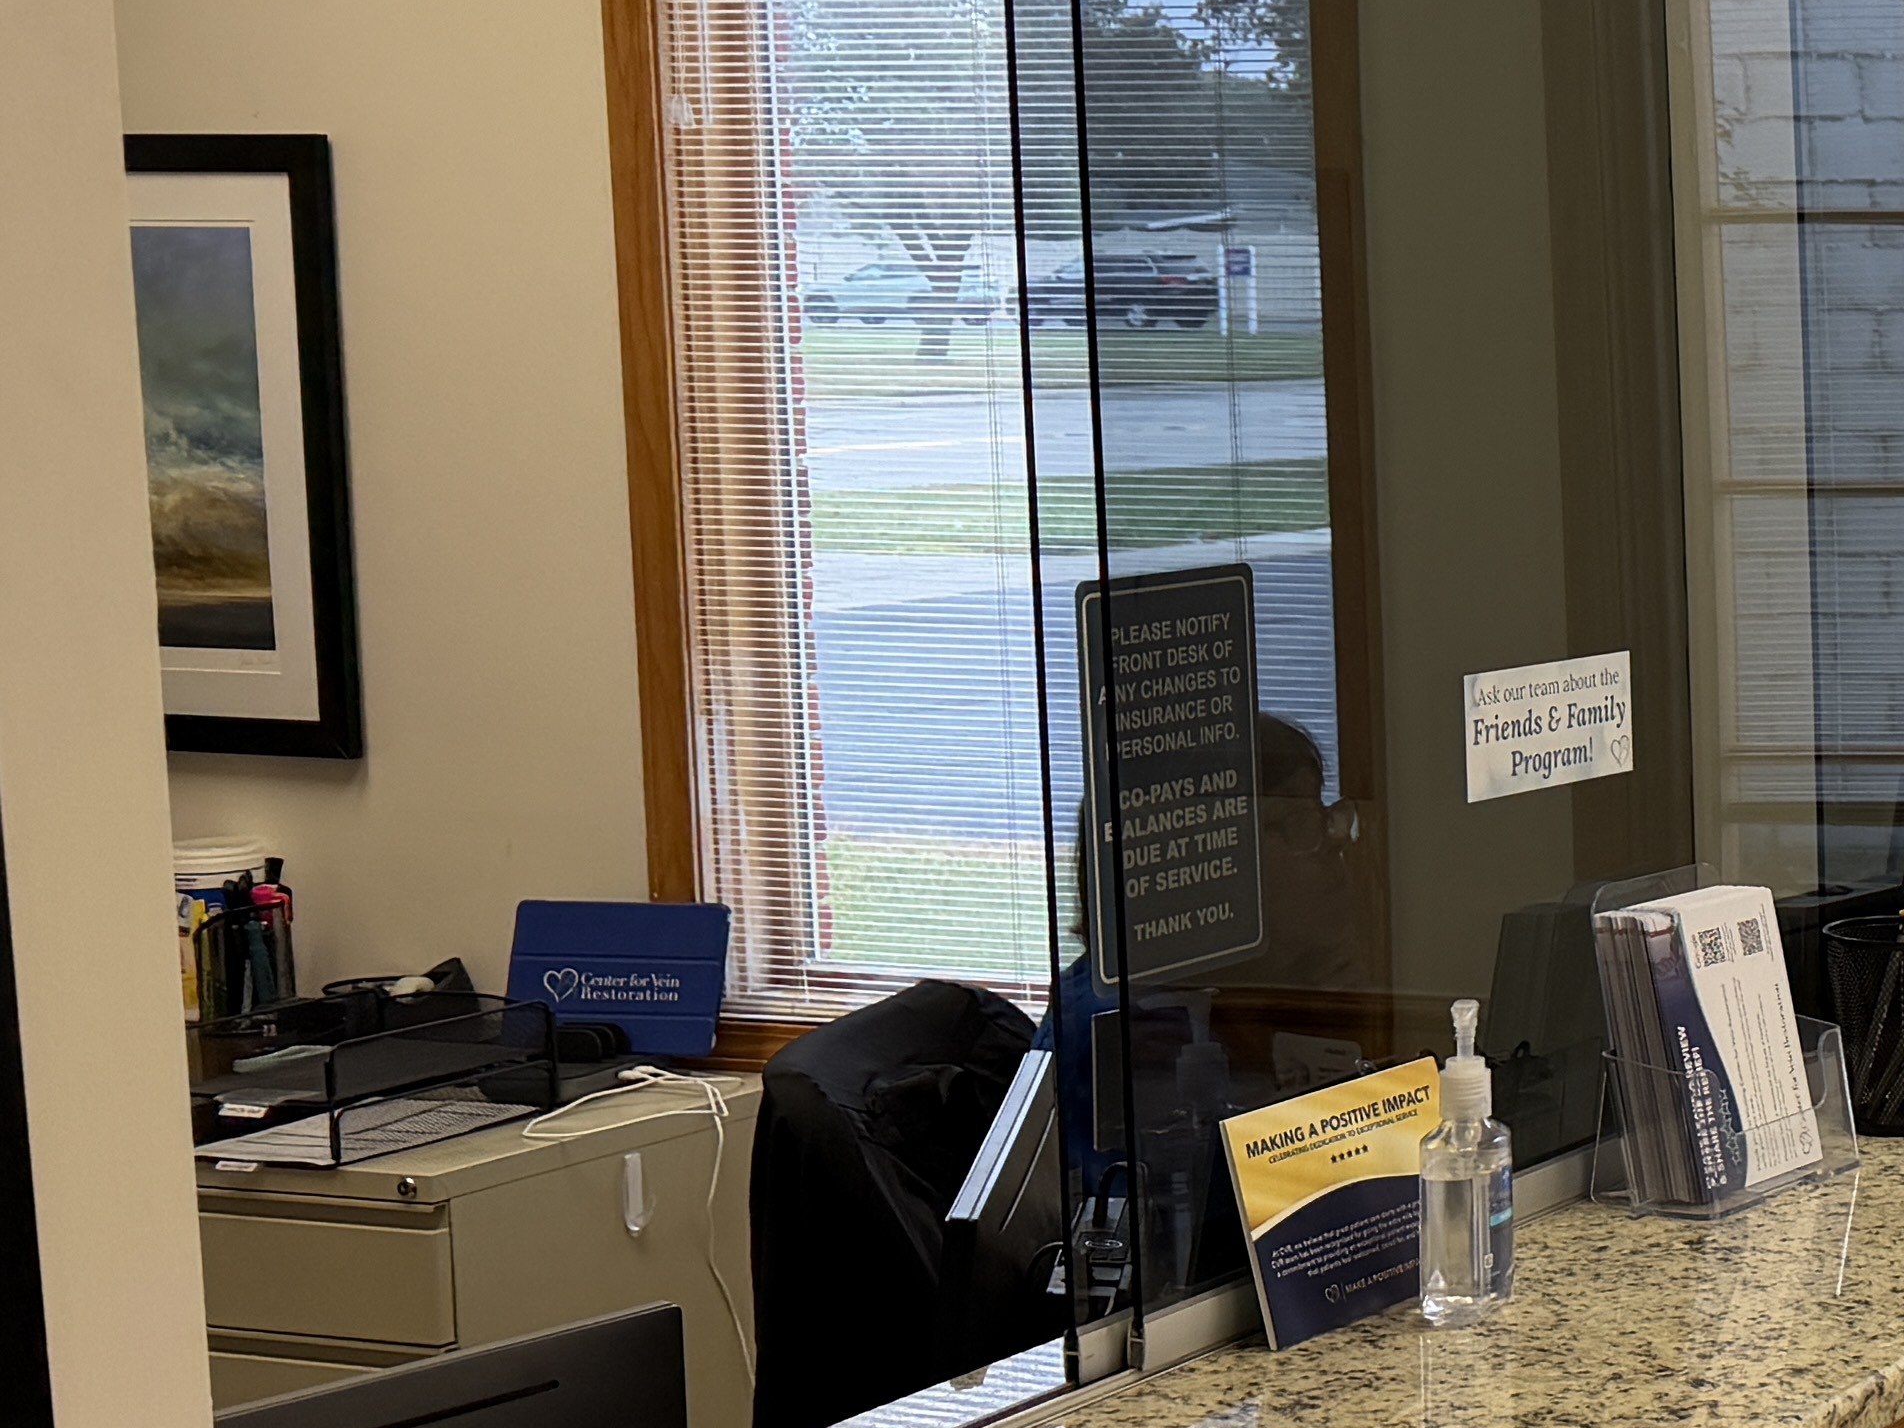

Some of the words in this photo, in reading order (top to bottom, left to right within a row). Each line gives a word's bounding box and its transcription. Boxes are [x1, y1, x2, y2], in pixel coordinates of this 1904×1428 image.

[1111, 620, 1171, 646] PLEASE
[1176, 613, 1230, 637] NOTIFY
[1167, 644, 1208, 667] DESK
[1213, 640, 1233, 659] OF
[1141, 670, 1216, 699] CHANGES
[1220, 666, 1240, 684] TO
[1478, 685, 1500, 706] Ask
[1504, 685, 1526, 702] our
[1529, 680, 1559, 698] team
[1563, 674, 1597, 692] about
[1600, 668, 1619, 686] the
[1116, 700, 1205, 732] INSURANCE
[1211, 695, 1232, 714] OR
[1473, 709, 1542, 745] Friends
[1548, 706, 1561, 732] &
[1567, 695, 1626, 728] Family
[1200, 723, 1240, 743] INFO.
[1511, 737, 1593, 779] Program!
[1119, 778, 1195, 810] CO-PAYS
[1200, 770, 1238, 795] AND
[1213, 796, 1248, 819] ARE
[1124, 845, 1160, 870] DUE
[1167, 838, 1189, 858] AT
[1195, 827, 1238, 853] TIME
[1126, 876, 1150, 898] OF
[1156, 857, 1237, 892] SERVICE.
[1134, 912, 1191, 941] THANK
[581, 972, 627, 986] Center
[630, 974, 650, 986] for
[581, 987, 678, 1001] Restoration
[1246, 1130, 1305, 1159] MAKING
[1308, 1123, 1319, 1138] A
[1321, 1103, 1379, 1134] POSITIVE
[1382, 1086, 1430, 1114] IMPACT
[1705, 1097, 1715, 1123] THE
